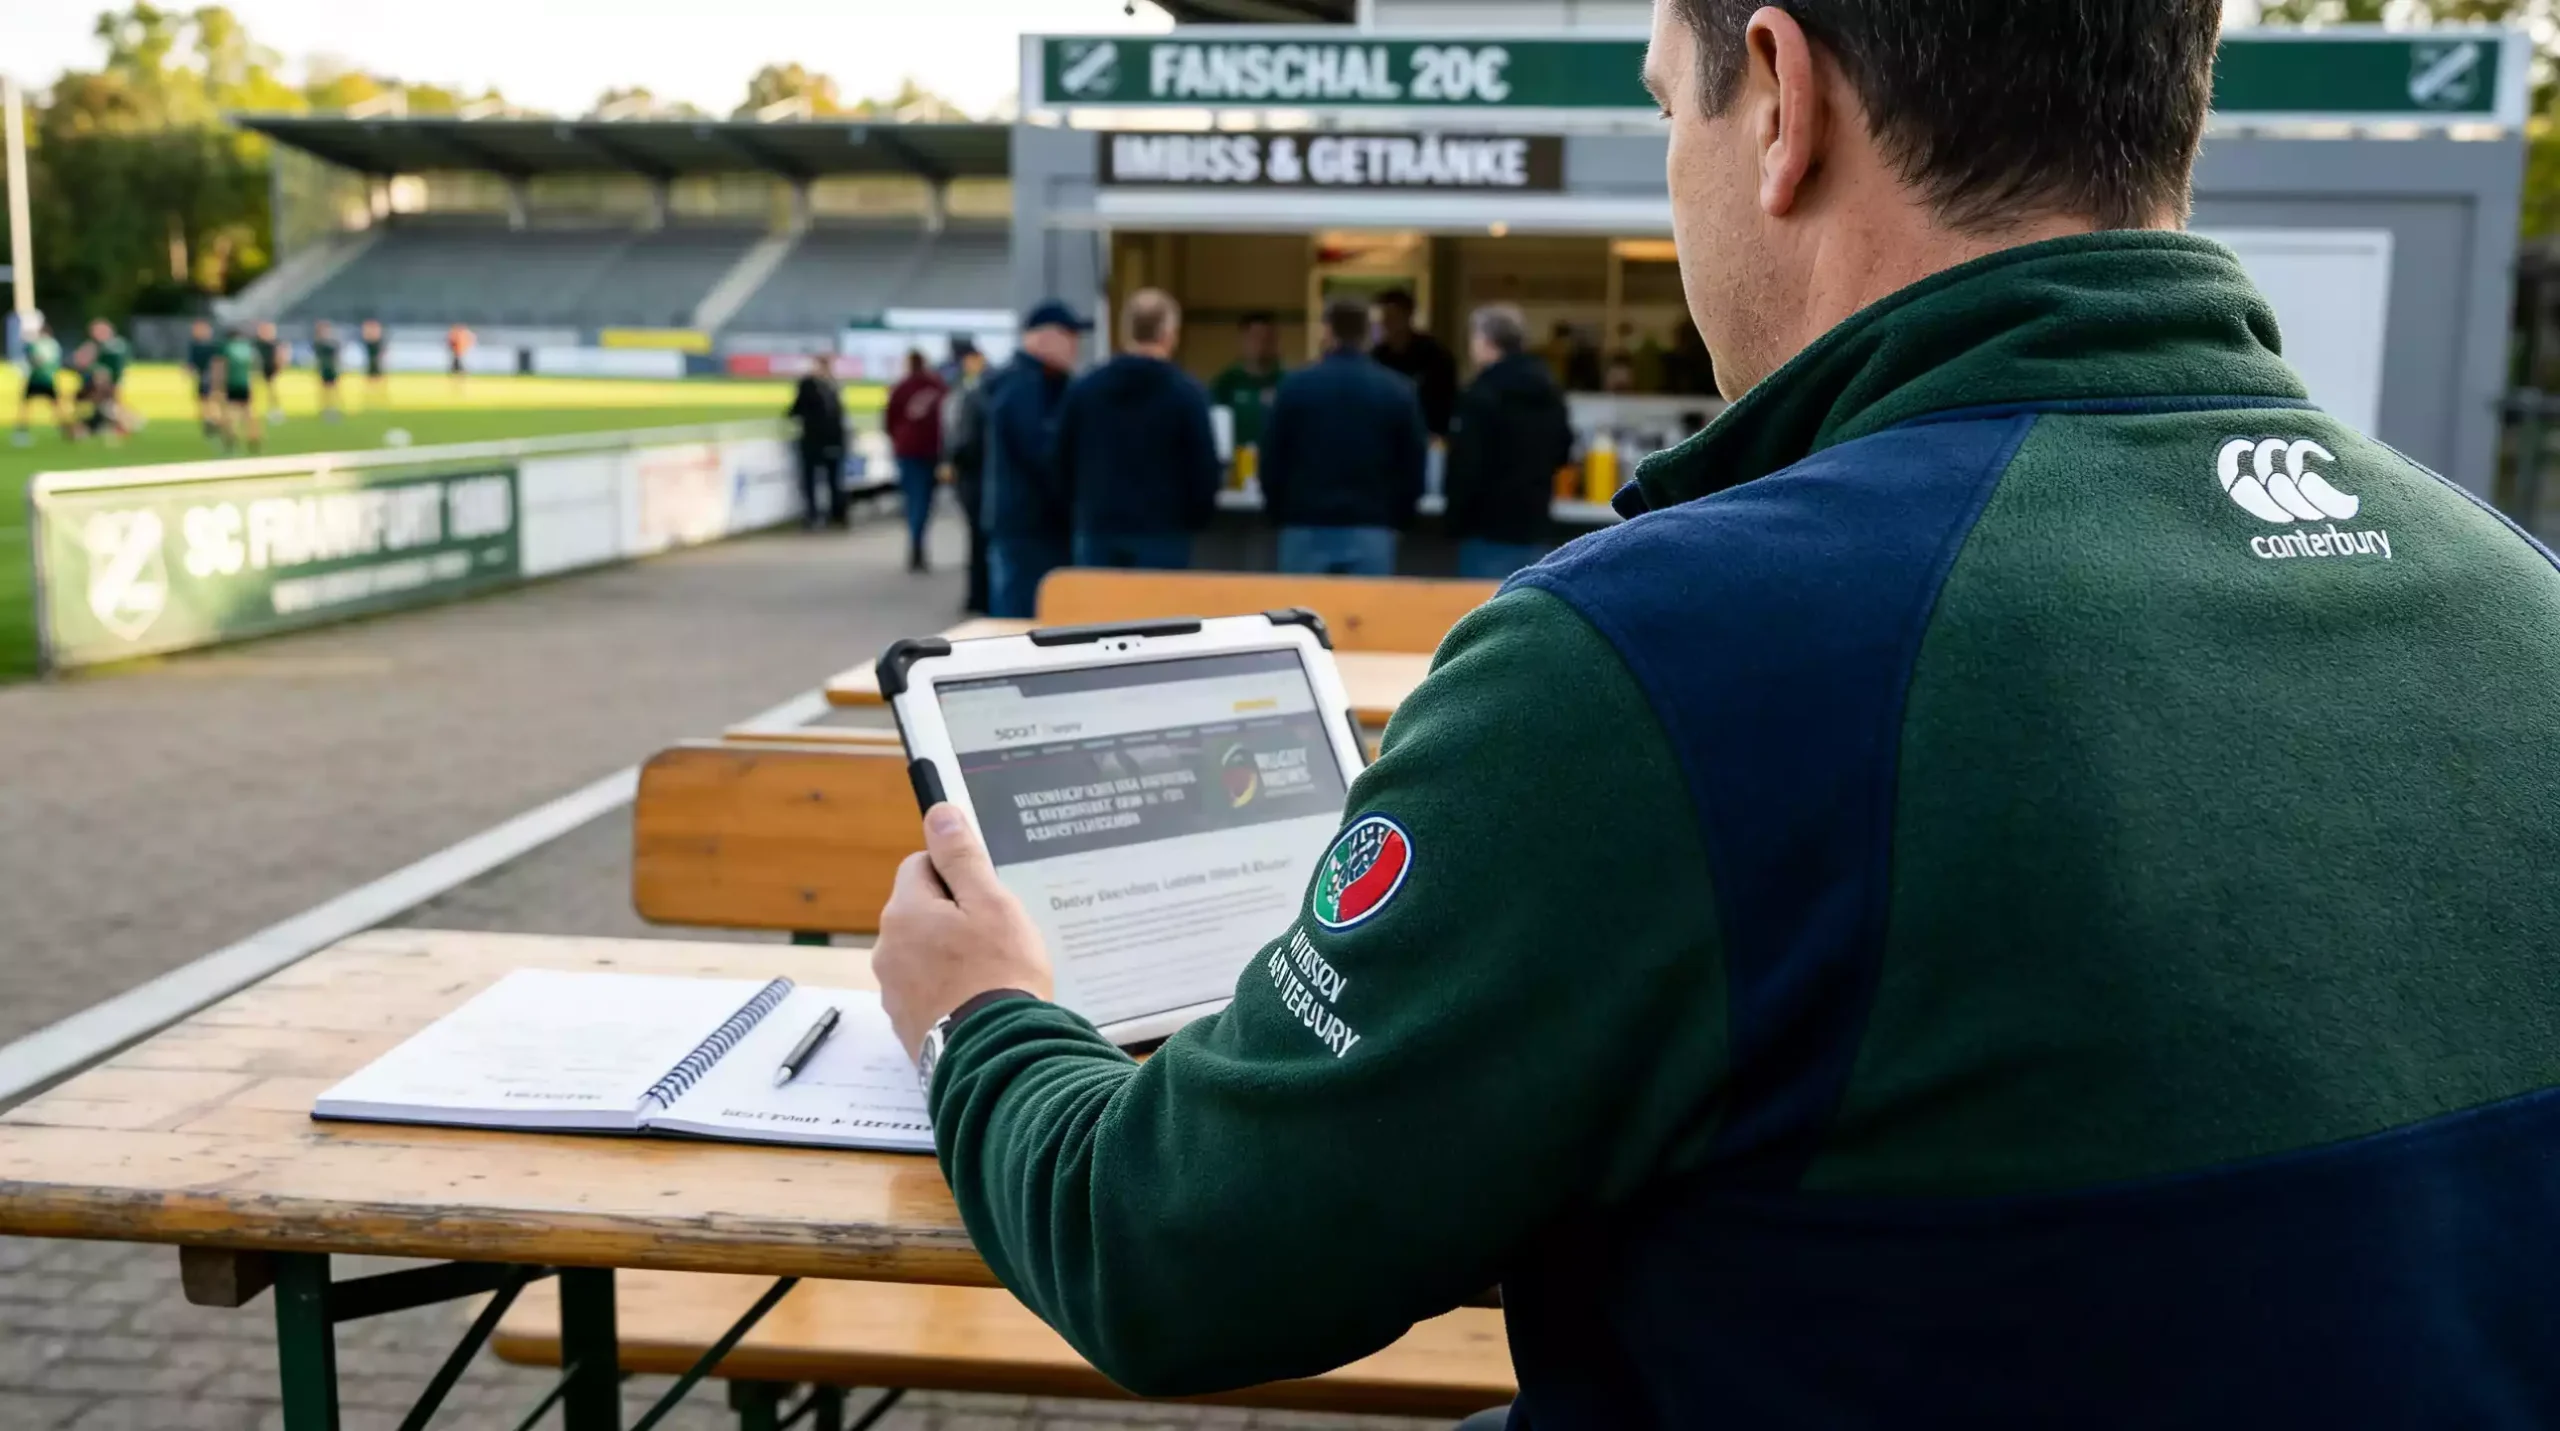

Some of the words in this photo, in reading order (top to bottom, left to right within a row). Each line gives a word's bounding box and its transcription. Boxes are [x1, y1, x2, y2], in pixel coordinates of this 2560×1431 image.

[1149, 46, 1398, 98] FANSCHAL
[1410, 46, 1511, 101] 20€
[1112, 134, 1260, 181] IMBISS
[1266, 136, 1300, 182] &
[1307, 130, 1529, 186] GETRÄNKE
[2250, 523, 2392, 559] canterbury
